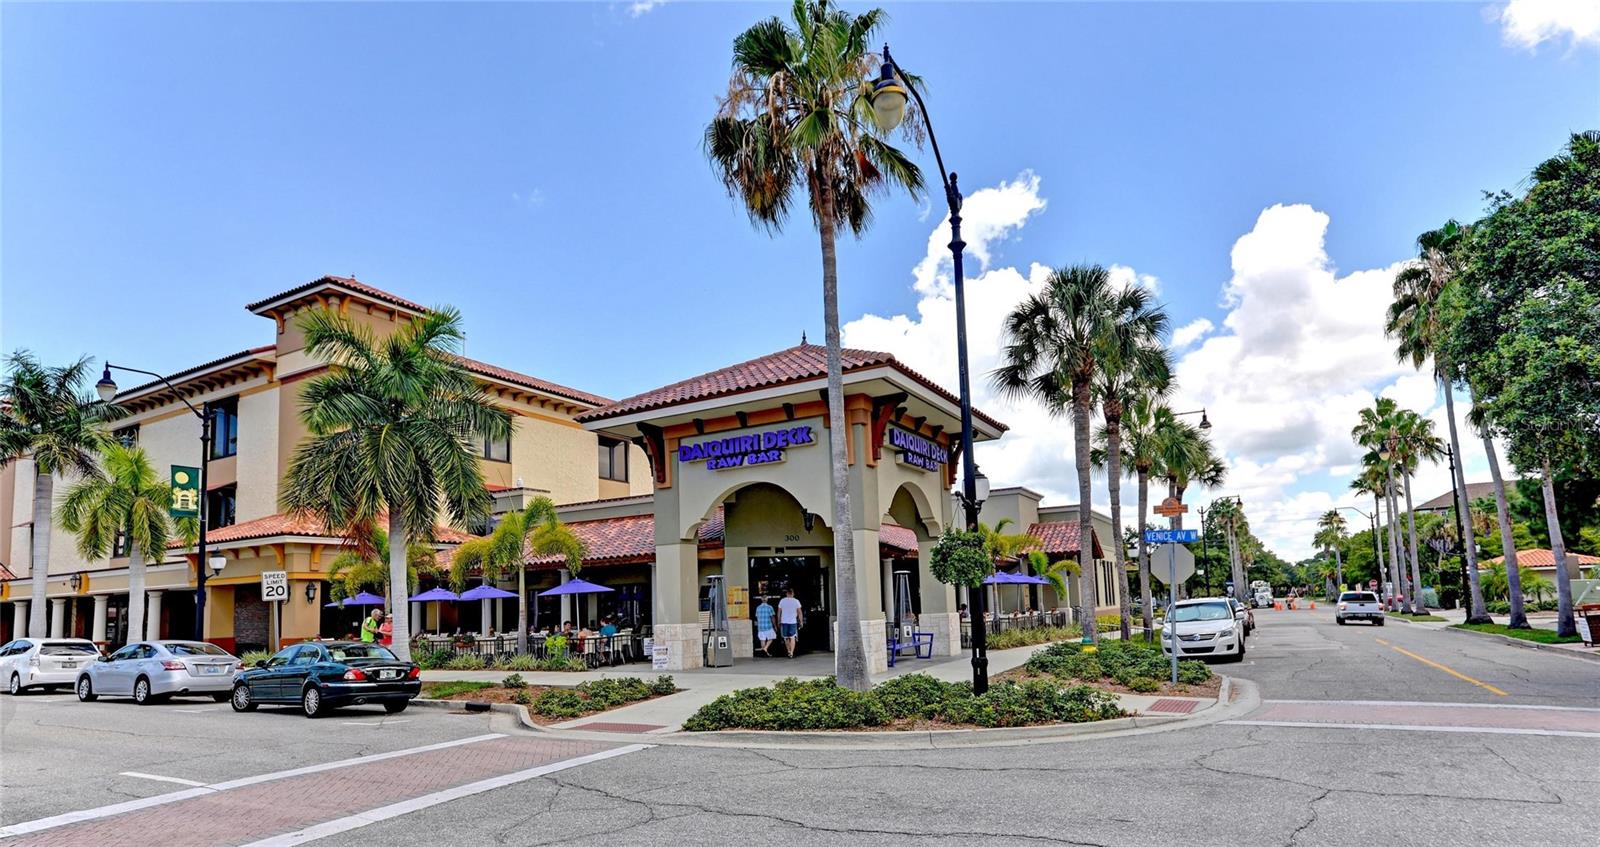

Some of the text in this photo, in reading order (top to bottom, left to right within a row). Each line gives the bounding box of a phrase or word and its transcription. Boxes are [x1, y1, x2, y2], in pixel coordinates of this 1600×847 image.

[680, 426, 813, 462] DAIQUIRI DECK
[893, 428, 949, 464] DAIQUIRI DECK
[706, 450, 783, 470] RAW BAR
[907, 452, 939, 471] RAW BAR
[784, 534, 800, 542] 300
[1146, 531, 1197, 541] VENICE AV W
[265, 585, 285, 597] 20
